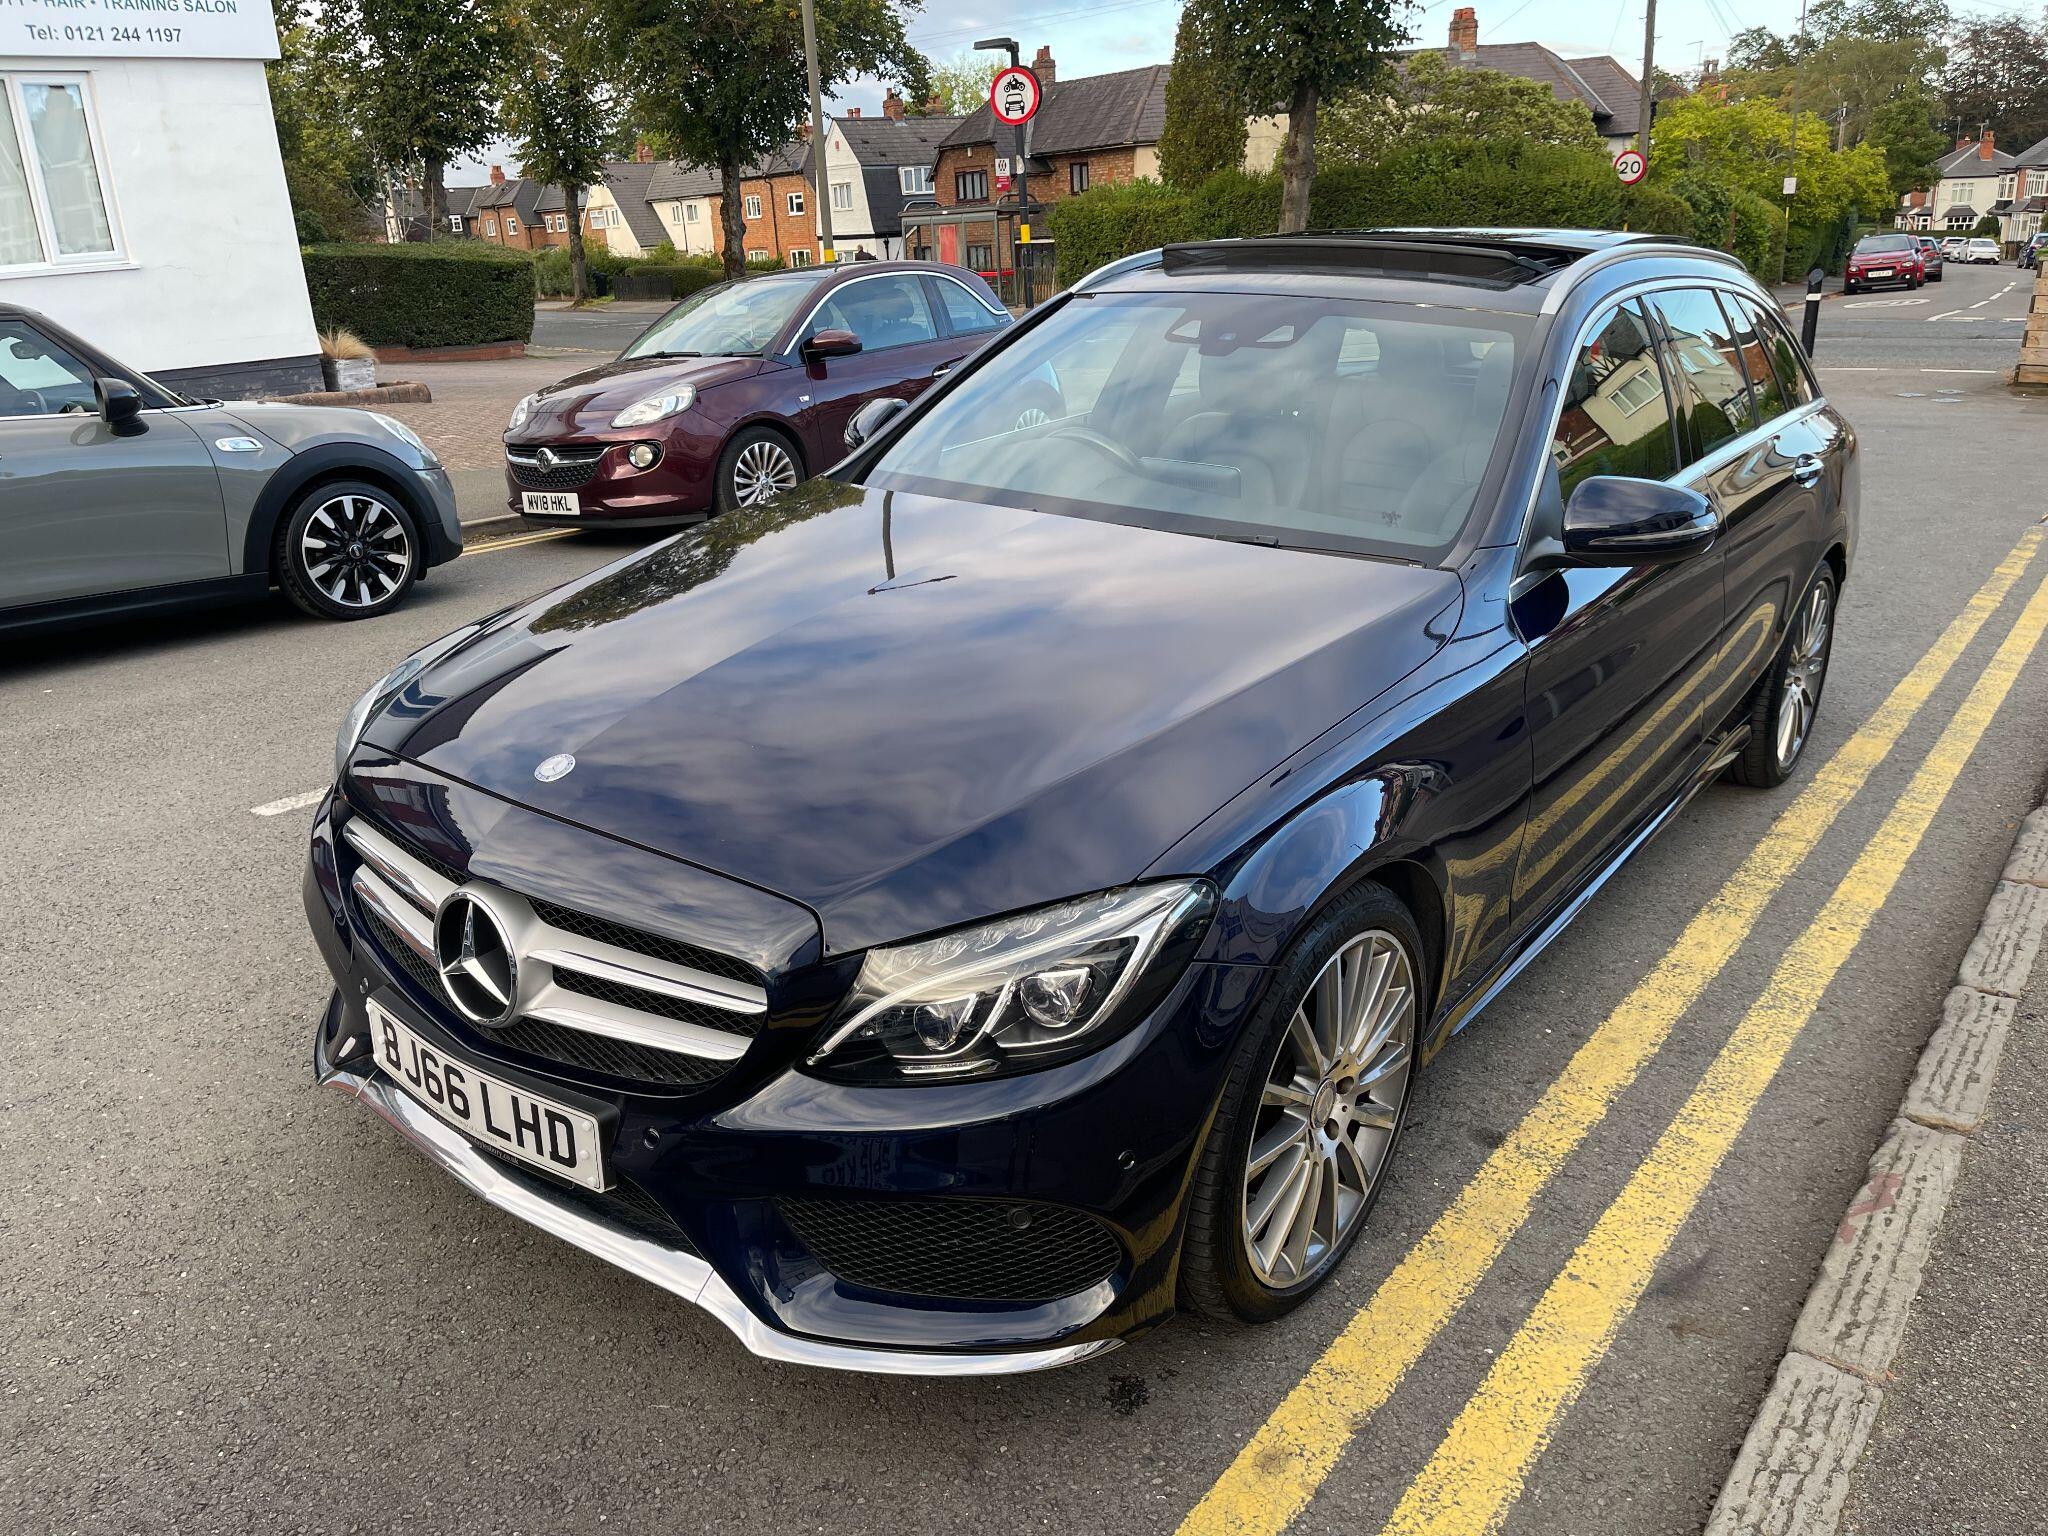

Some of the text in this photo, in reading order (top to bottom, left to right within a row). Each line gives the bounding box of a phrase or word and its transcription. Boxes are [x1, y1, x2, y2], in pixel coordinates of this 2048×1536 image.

[103, 0, 179, 11] TRAINING
[184, 0, 237, 13] SALON
[24, 24, 181, 42] Tel: 0121 244 1197
[1619, 161, 1641, 174] 20
[550, 495, 572, 511] HKL
[380, 1014, 471, 1120] BJ66
[480, 1081, 577, 1168] LHD
